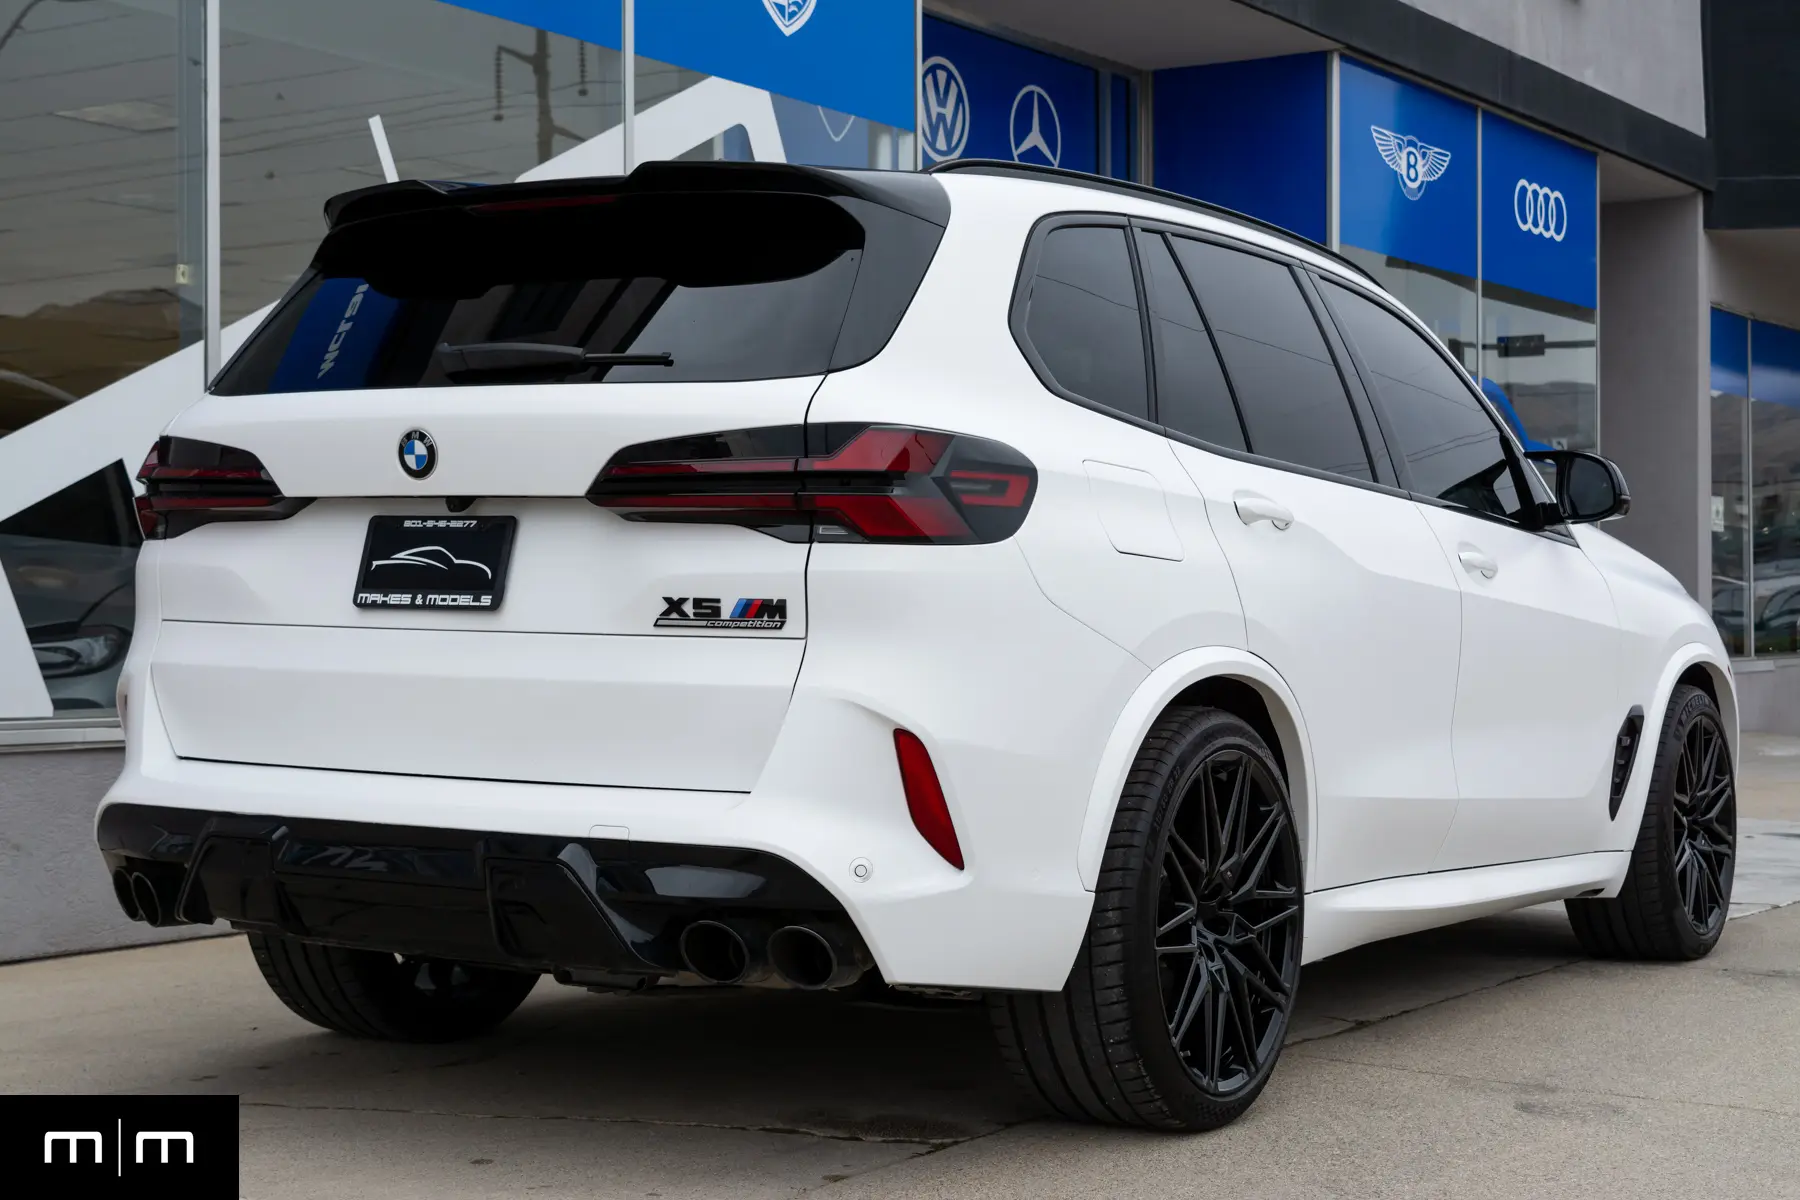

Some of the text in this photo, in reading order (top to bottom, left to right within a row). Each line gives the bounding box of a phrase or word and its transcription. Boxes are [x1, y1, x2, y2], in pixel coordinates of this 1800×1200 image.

[400, 431, 433, 447] BMW
[357, 593, 492, 606] MAKES & MODELS
[658, 597, 787, 619] X5 M
[706, 620, 781, 628] competition
